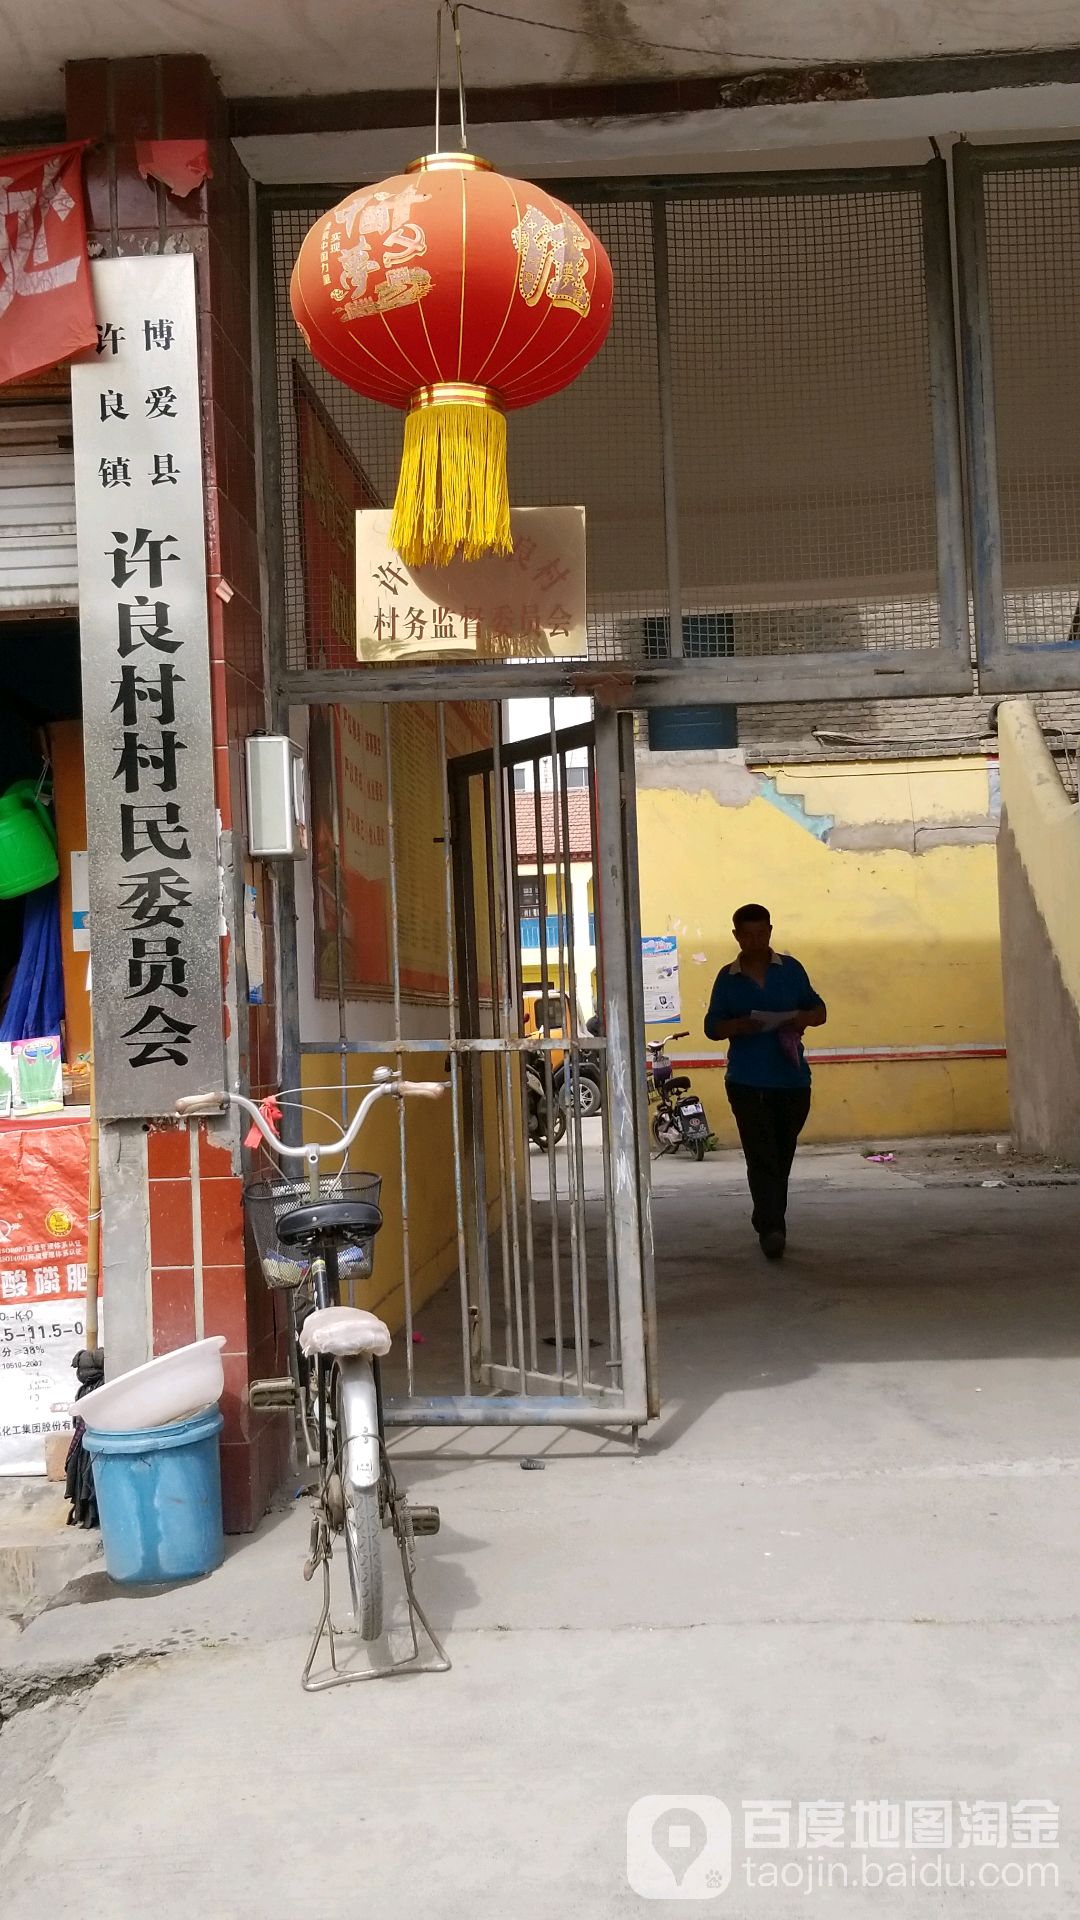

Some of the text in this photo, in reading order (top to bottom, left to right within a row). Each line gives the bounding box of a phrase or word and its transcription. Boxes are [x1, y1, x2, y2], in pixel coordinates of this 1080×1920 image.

[95, 322, 132, 488] 许良镇
[142, 318, 181, 486] 博爱县
[373, 603, 573, 641] 村务监督委员会
[104, 528, 198, 1068] 许良村村民委员会
[0, 1263, 88, 1298] 酸磷肥
[0, 1420, 72, 1437] 化工集团股份有
